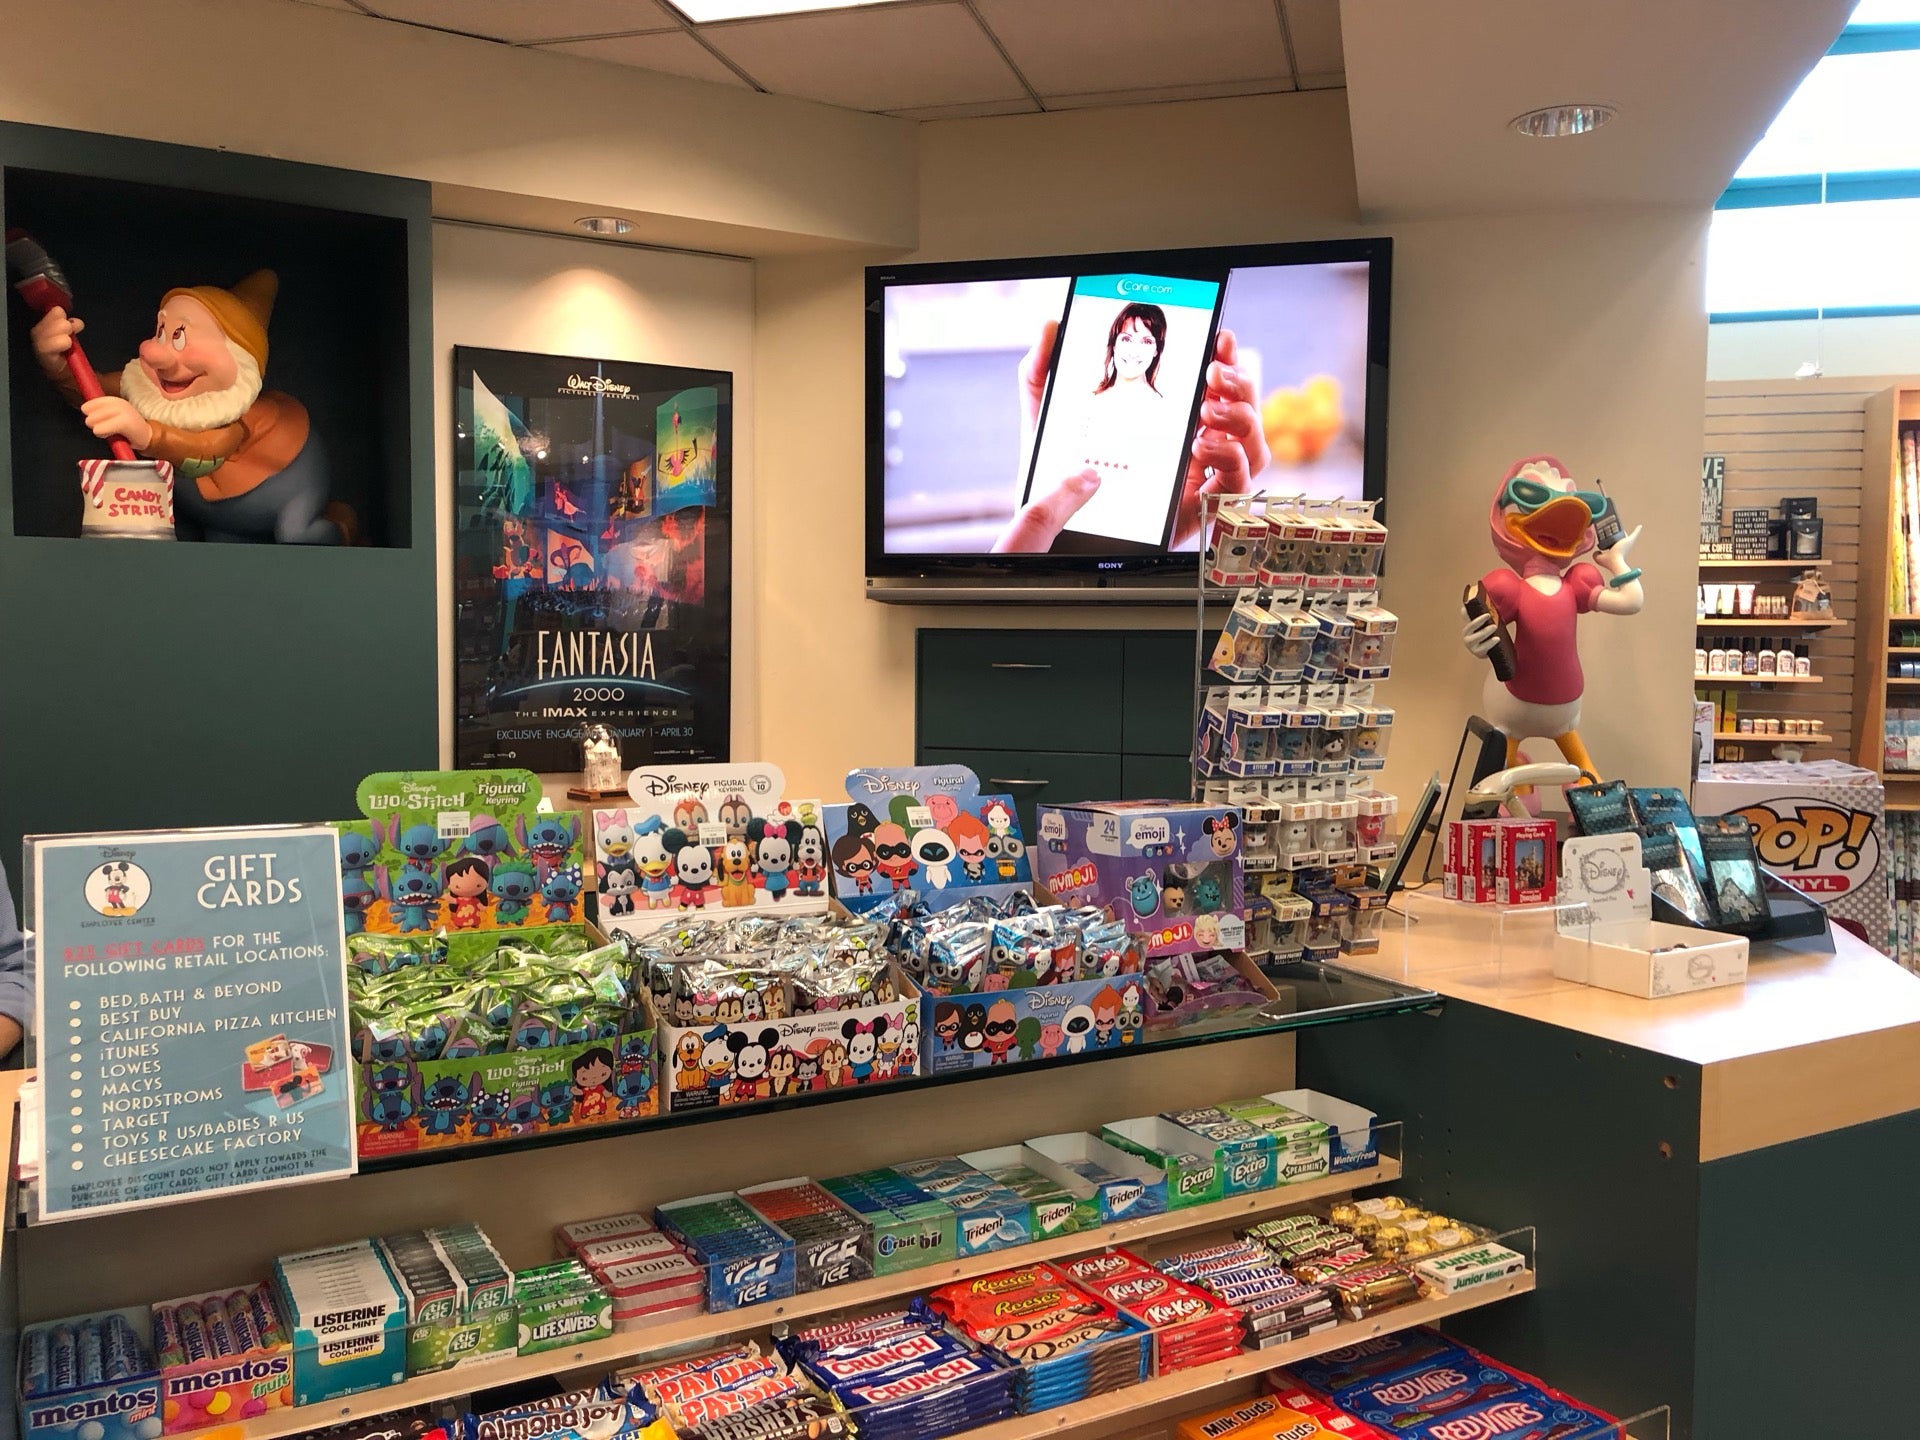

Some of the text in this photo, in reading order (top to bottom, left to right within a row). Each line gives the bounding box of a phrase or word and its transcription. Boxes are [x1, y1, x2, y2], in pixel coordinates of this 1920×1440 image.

[114, 487, 162, 504] CANDY
[108, 503, 166, 519] STRIPE
[1098, 562, 1124, 570] SONY
[537, 630, 656, 681] FANTASIA
[573, 687, 625, 702] 2000
[543, 707, 589, 718] IMAX
[592, 710, 678, 718] EXPERIENCE
[497, 729, 542, 740] EXCLUSIVE
[661, 727, 682, 737] APRIL
[683, 727, 693, 737] 30
[477, 781, 527, 796] Figural
[713, 779, 748, 788] FIGURAL
[755, 783, 766, 791] 10
[931, 774, 965, 787] Figural
[485, 796, 520, 806] Keyring
[1043, 824, 1063, 839] emoji
[1103, 818, 1115, 835] 24
[1134, 828, 1166, 842] emoji
[1722, 804, 1878, 872] POP!
[204, 852, 277, 884] GIFT
[196, 876, 303, 909] CARDS
[106, 940, 142, 957] GIFT
[151, 936, 206, 956] CARDS
[212, 934, 246, 949] FOR
[254, 930, 282, 946] THE
[63, 945, 330, 979] FOLLOWING RETAIL LOCATIONS:
[193, 987, 206, 1001] &
[214, 979, 284, 1000] BEYOND
[99, 1006, 182, 1028] BEST BUY
[99, 1007, 338, 1046] CALIFORNIA PIZZA KITCHEN
[99, 1060, 163, 1080] LOWES
[101, 1077, 164, 1097] MACYS
[685, 1089, 709, 1098] WARNING
[102, 1086, 225, 1116] NORDSTROMS
[101, 1110, 172, 1133] TARGET
[1177, 1108, 1220, 1124] Extra
[102, 1110, 305, 1151] TOYS R US/BABIES R US
[1208, 1124, 1253, 1141] Extra
[102, 1126, 304, 1170] CHEESECAKE FACTORY
[1239, 1140, 1258, 1151] Extra
[1234, 1155, 1267, 1181] Extra
[1285, 1159, 1326, 1177] SPEARMINT
[1333, 1150, 1378, 1167] Winterfresh
[71, 1186, 121, 1204] PURCHASE
[124, 1184, 140, 1196] OF
[144, 1179, 165, 1193] GIFT
[205, 1172, 227, 1185] GIFT
[230, 1167, 260, 1181] CARDS
[262, 1160, 302, 1176] CANNOT
[304, 1159, 316, 1170] BE
[72, 1147, 328, 1195] EMPLOYEE DISCOUNT DOES NOT APPLY TOWARDS THE
[1181, 1166, 1215, 1192] Extra
[926, 1174, 968, 1193] Trident
[950, 1189, 992, 1209] Trident
[1106, 1184, 1144, 1209] Trident
[1037, 1201, 1077, 1228] Trident
[574, 1217, 641, 1236] ALTOIDS
[964, 1216, 1004, 1243] Trident
[595, 1236, 664, 1256] ALTOIDS
[877, 1233, 917, 1257] Orbit
[1181, 1239, 1253, 1262] Musketeers
[614, 1257, 686, 1279] ALTOIDS
[1434, 1247, 1493, 1272] Junior
[1476, 1247, 1515, 1267] Mints
[821, 1262, 851, 1287] ICE
[971, 1272, 1037, 1295] Reese's
[1212, 1265, 1282, 1288] SNICKERS
[1452, 1268, 1506, 1292] Junior Mints
[481, 1289, 502, 1302] tic
[737, 1280, 769, 1306] ICE
[1225, 1274, 1296, 1300] SNICKERS
[429, 1300, 450, 1313] tic
[476, 1297, 501, 1309] tac
[994, 1292, 1063, 1317] Reese's
[313, 1304, 387, 1328] LISTERINE
[321, 1318, 379, 1335] COOL MINT
[424, 1309, 449, 1323] tac
[457, 1330, 476, 1343] tic
[532, 1325, 558, 1342] LIFE
[557, 1314, 599, 1336] SAVERS
[322, 1333, 381, 1354] LISTERINE
[329, 1344, 375, 1360] COOL MINT
[453, 1337, 476, 1351] tac
[830, 1336, 935, 1376] CRUNCH
[170, 1356, 290, 1397] mentos
[655, 1356, 777, 1405] PAYDAY
[866, 1358, 975, 1402] CRUNCH
[251, 1375, 290, 1401] fruit
[344, 1386, 352, 1395] 24
[1371, 1380, 1421, 1408] RED
[1411, 1368, 1470, 1397] VINES
[31, 1387, 158, 1429] mentos
[679, 1375, 799, 1428] PAYDAY
[129, 1404, 157, 1425] mint
[478, 1403, 623, 1440] Almond Joy
[1201, 1415, 1240, 1438] Milk
[1235, 1399, 1276, 1422] Duds
[1427, 1413, 1479, 1440] RED
[1474, 1401, 1545, 1434] VINES
[1275, 1421, 1317, 1440] Duds
